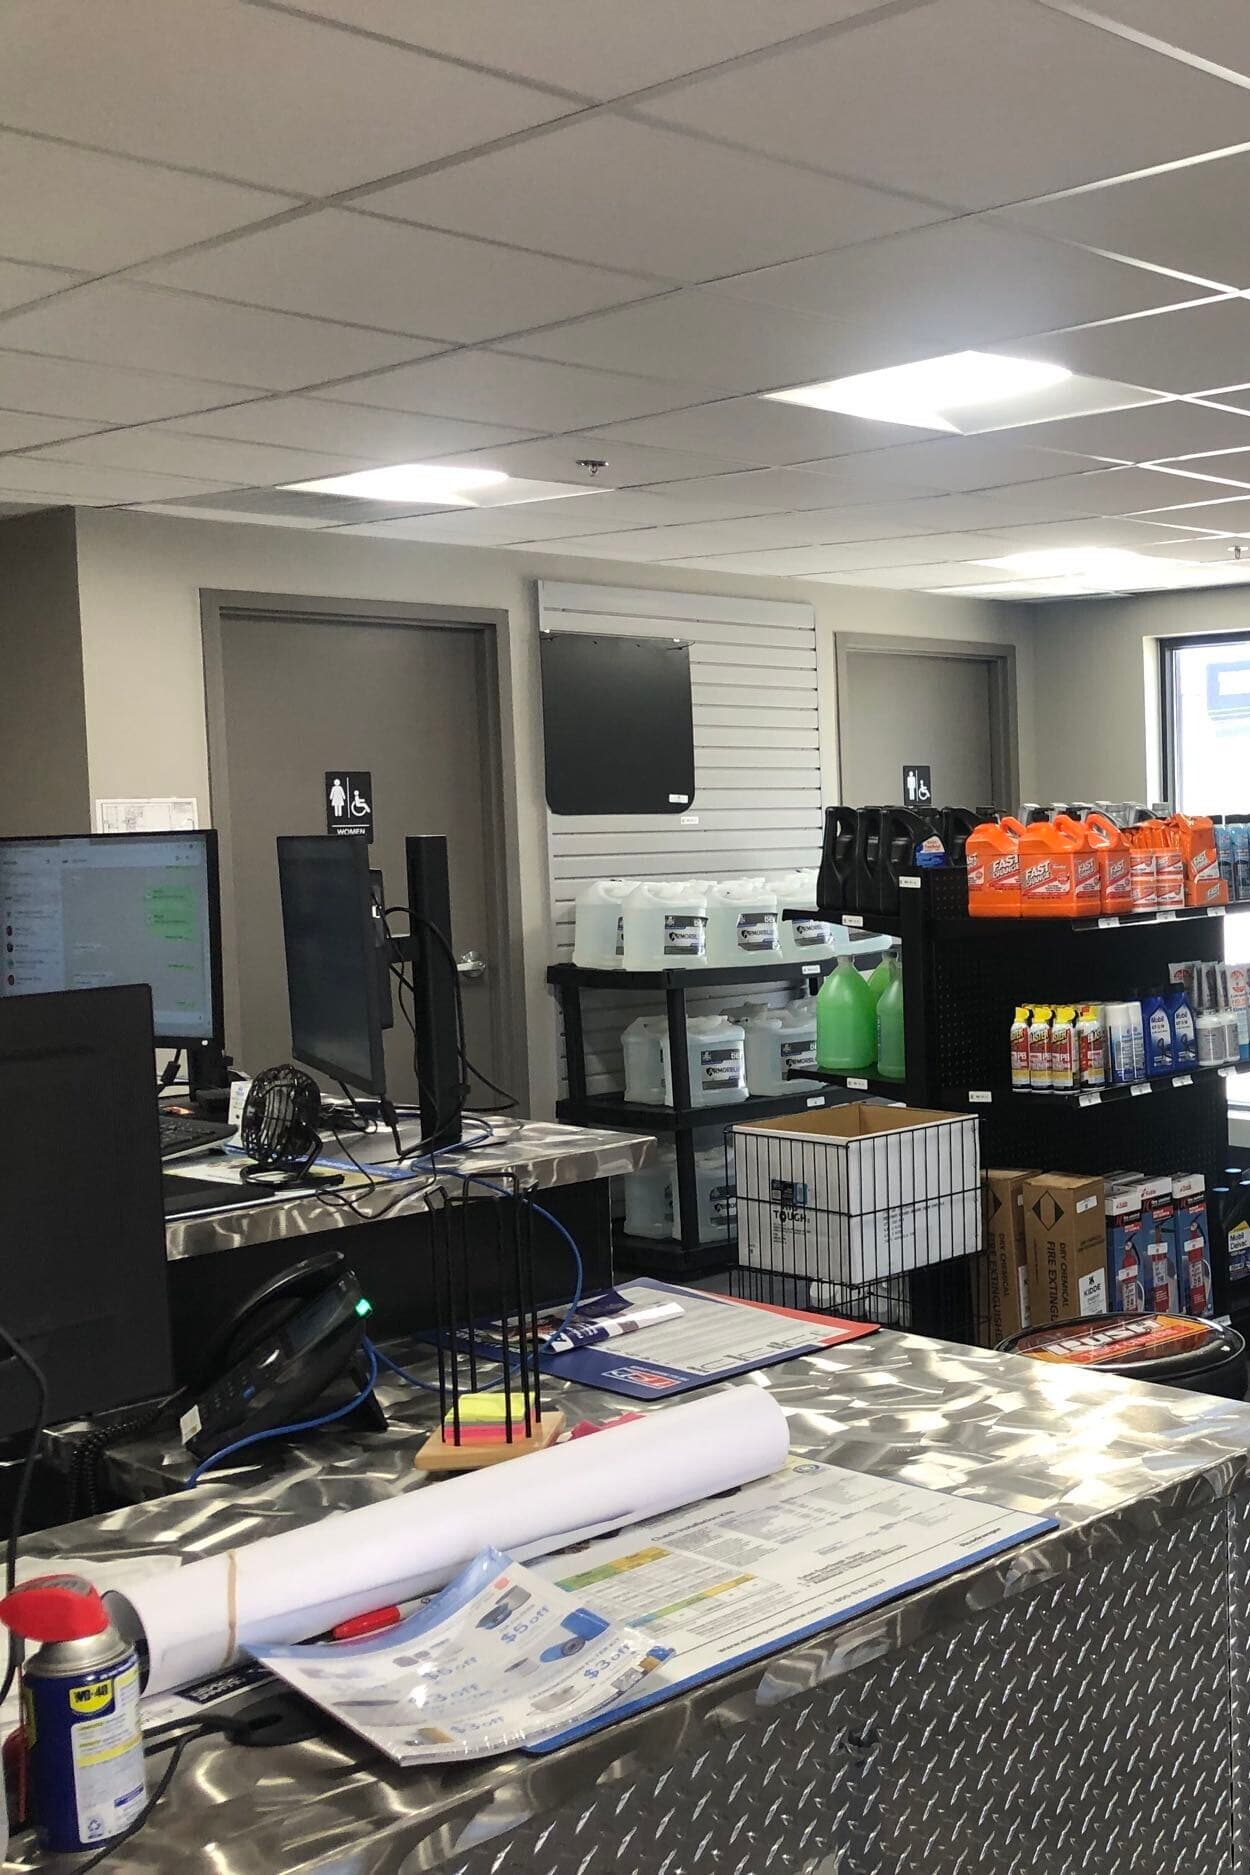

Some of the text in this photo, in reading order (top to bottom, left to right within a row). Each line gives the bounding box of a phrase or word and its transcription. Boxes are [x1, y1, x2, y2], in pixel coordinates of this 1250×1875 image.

[336, 828, 366, 836] WOMEN
[1025, 860, 1050, 880] FAST
[1077, 858, 1094, 873] FAST
[1151, 1015, 1165, 1023] Mobil
[1176, 1011, 1188, 1020] Mobil
[1230, 1232, 1244, 1240] Mobil
[1048, 1241, 1056, 1265] FIRE
[1230, 1241, 1247, 1250] Delvac
[1000, 1255, 1010, 1296] CHEMICAL
[1061, 1264, 1069, 1307] CHEMICAL
[1083, 1284, 1102, 1297] KIDDE
[1043, 1320, 1163, 1355] RUSH
[501, 1605, 550, 1644] $5 off
[583, 1643, 632, 1680] $3 off
[75, 1685, 108, 1703] WD-40
